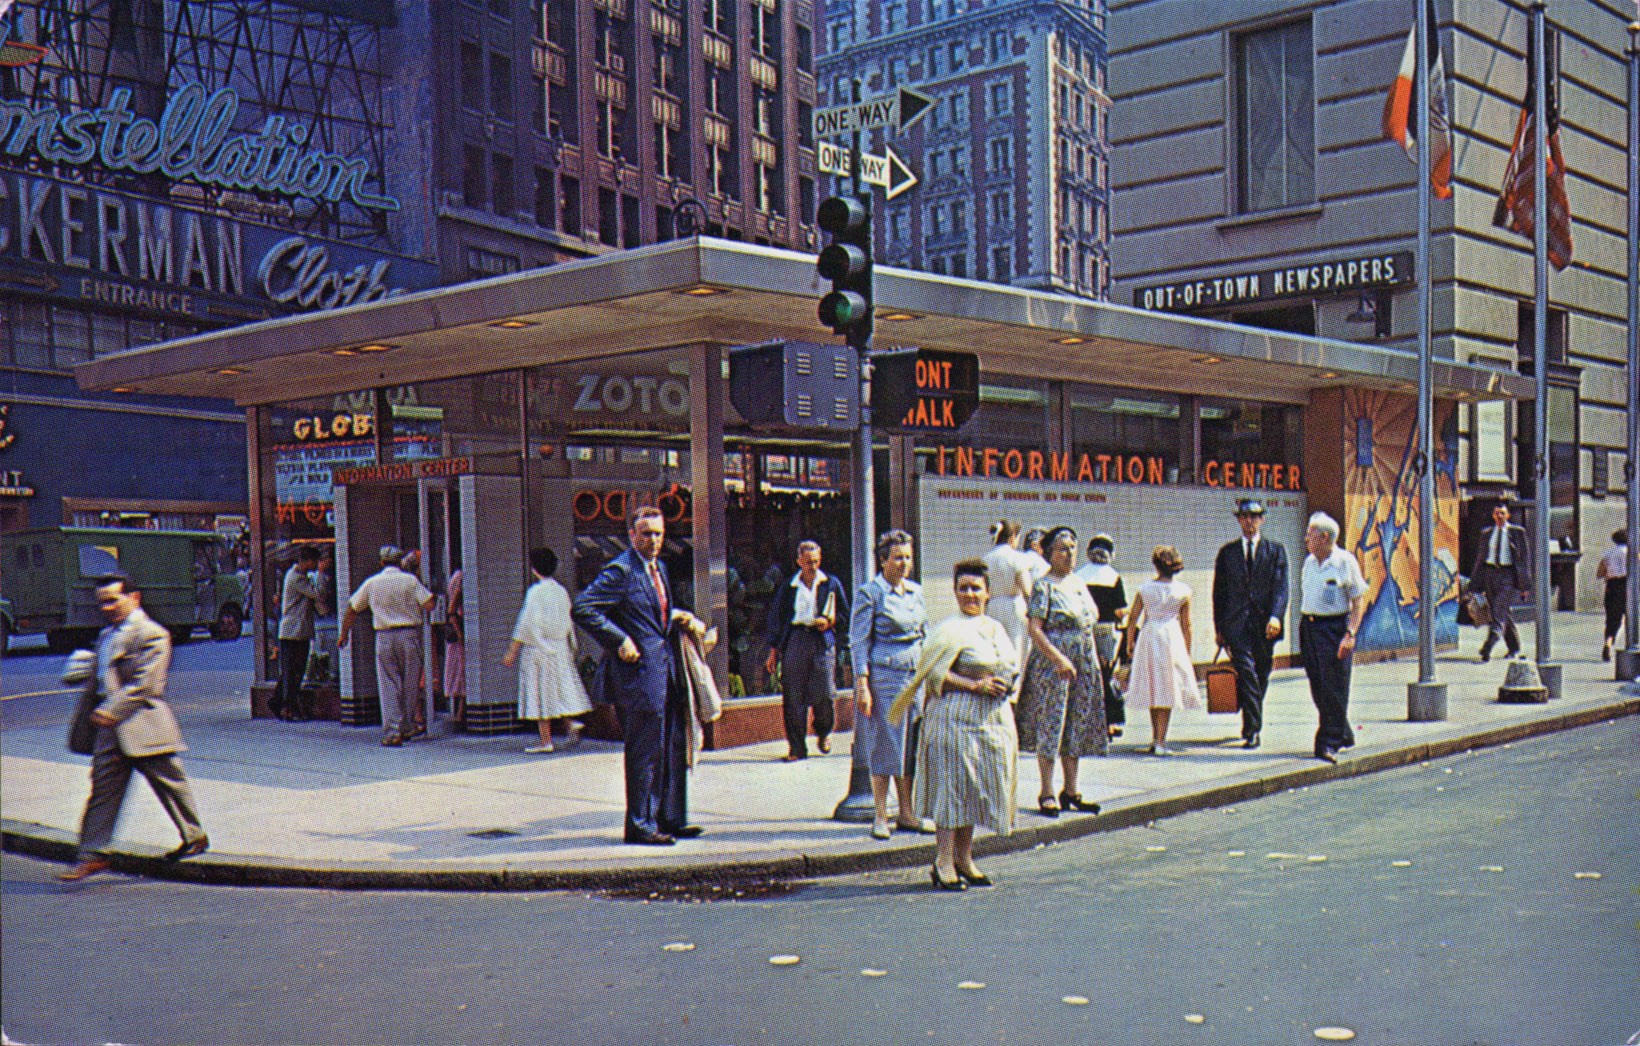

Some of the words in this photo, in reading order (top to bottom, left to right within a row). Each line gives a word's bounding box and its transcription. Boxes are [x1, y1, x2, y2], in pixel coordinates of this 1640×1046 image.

[815, 109, 849, 133] ONE
[859, 100, 893, 125] WAY
[0, 83, 400, 210] nstellation
[821, 146, 849, 172] ONE
[258, 236, 408, 310] Cloth
[1274, 256, 1395, 294] NEWSPAPERS
[80, 278, 192, 314] ENTRANCE
[915, 359, 952, 389] ONT
[573, 375, 690, 416] ZOTO
[293, 413, 377, 440] GLOB
[335, 463, 412, 482] INFORMATION
[421, 457, 469, 476] CENTER
[937, 445, 1164, 485] INFORMATION
[1205, 460, 1302, 491] CENTER
